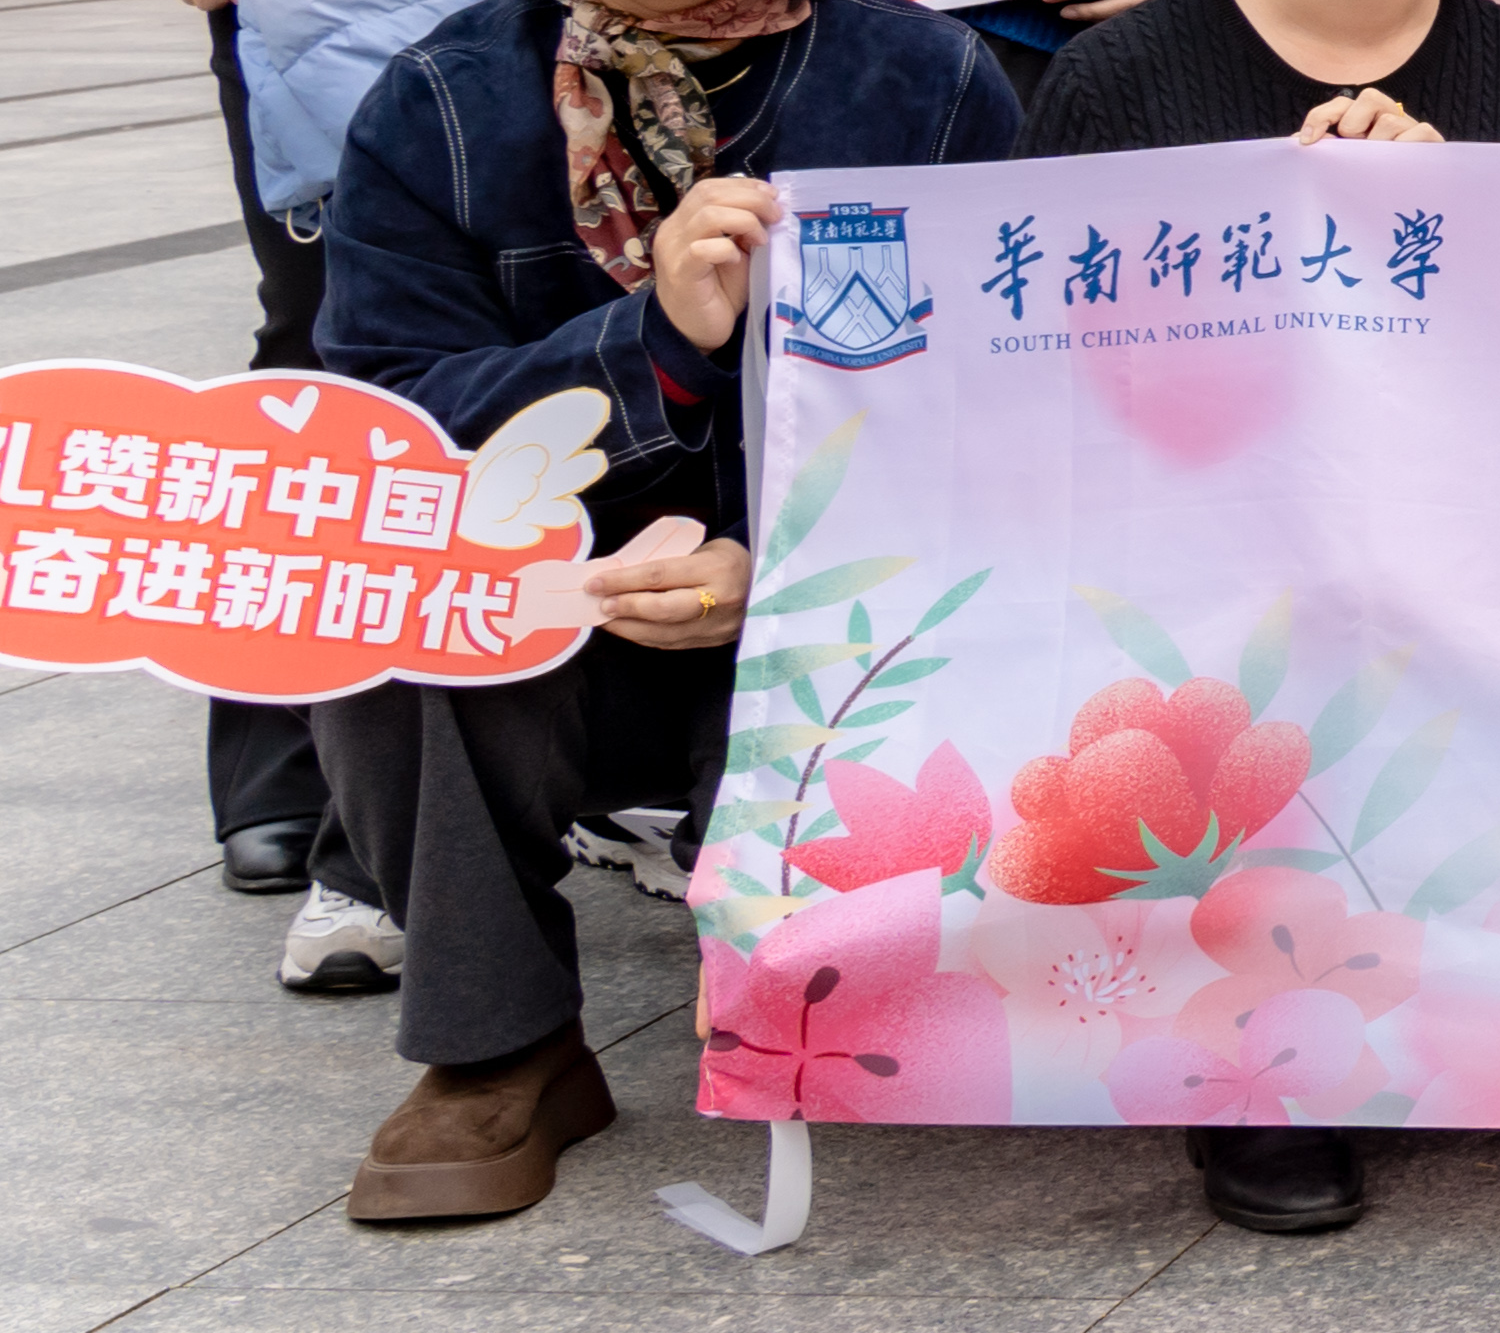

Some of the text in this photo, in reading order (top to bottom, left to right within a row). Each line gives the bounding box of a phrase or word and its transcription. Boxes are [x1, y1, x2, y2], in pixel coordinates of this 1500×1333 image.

[831, 205, 870, 216] 1933
[990, 311, 1431, 354] SOUTH CHINA NORMAL UNIVERSITY
[8, 527, 514, 656] 奋进新时代
